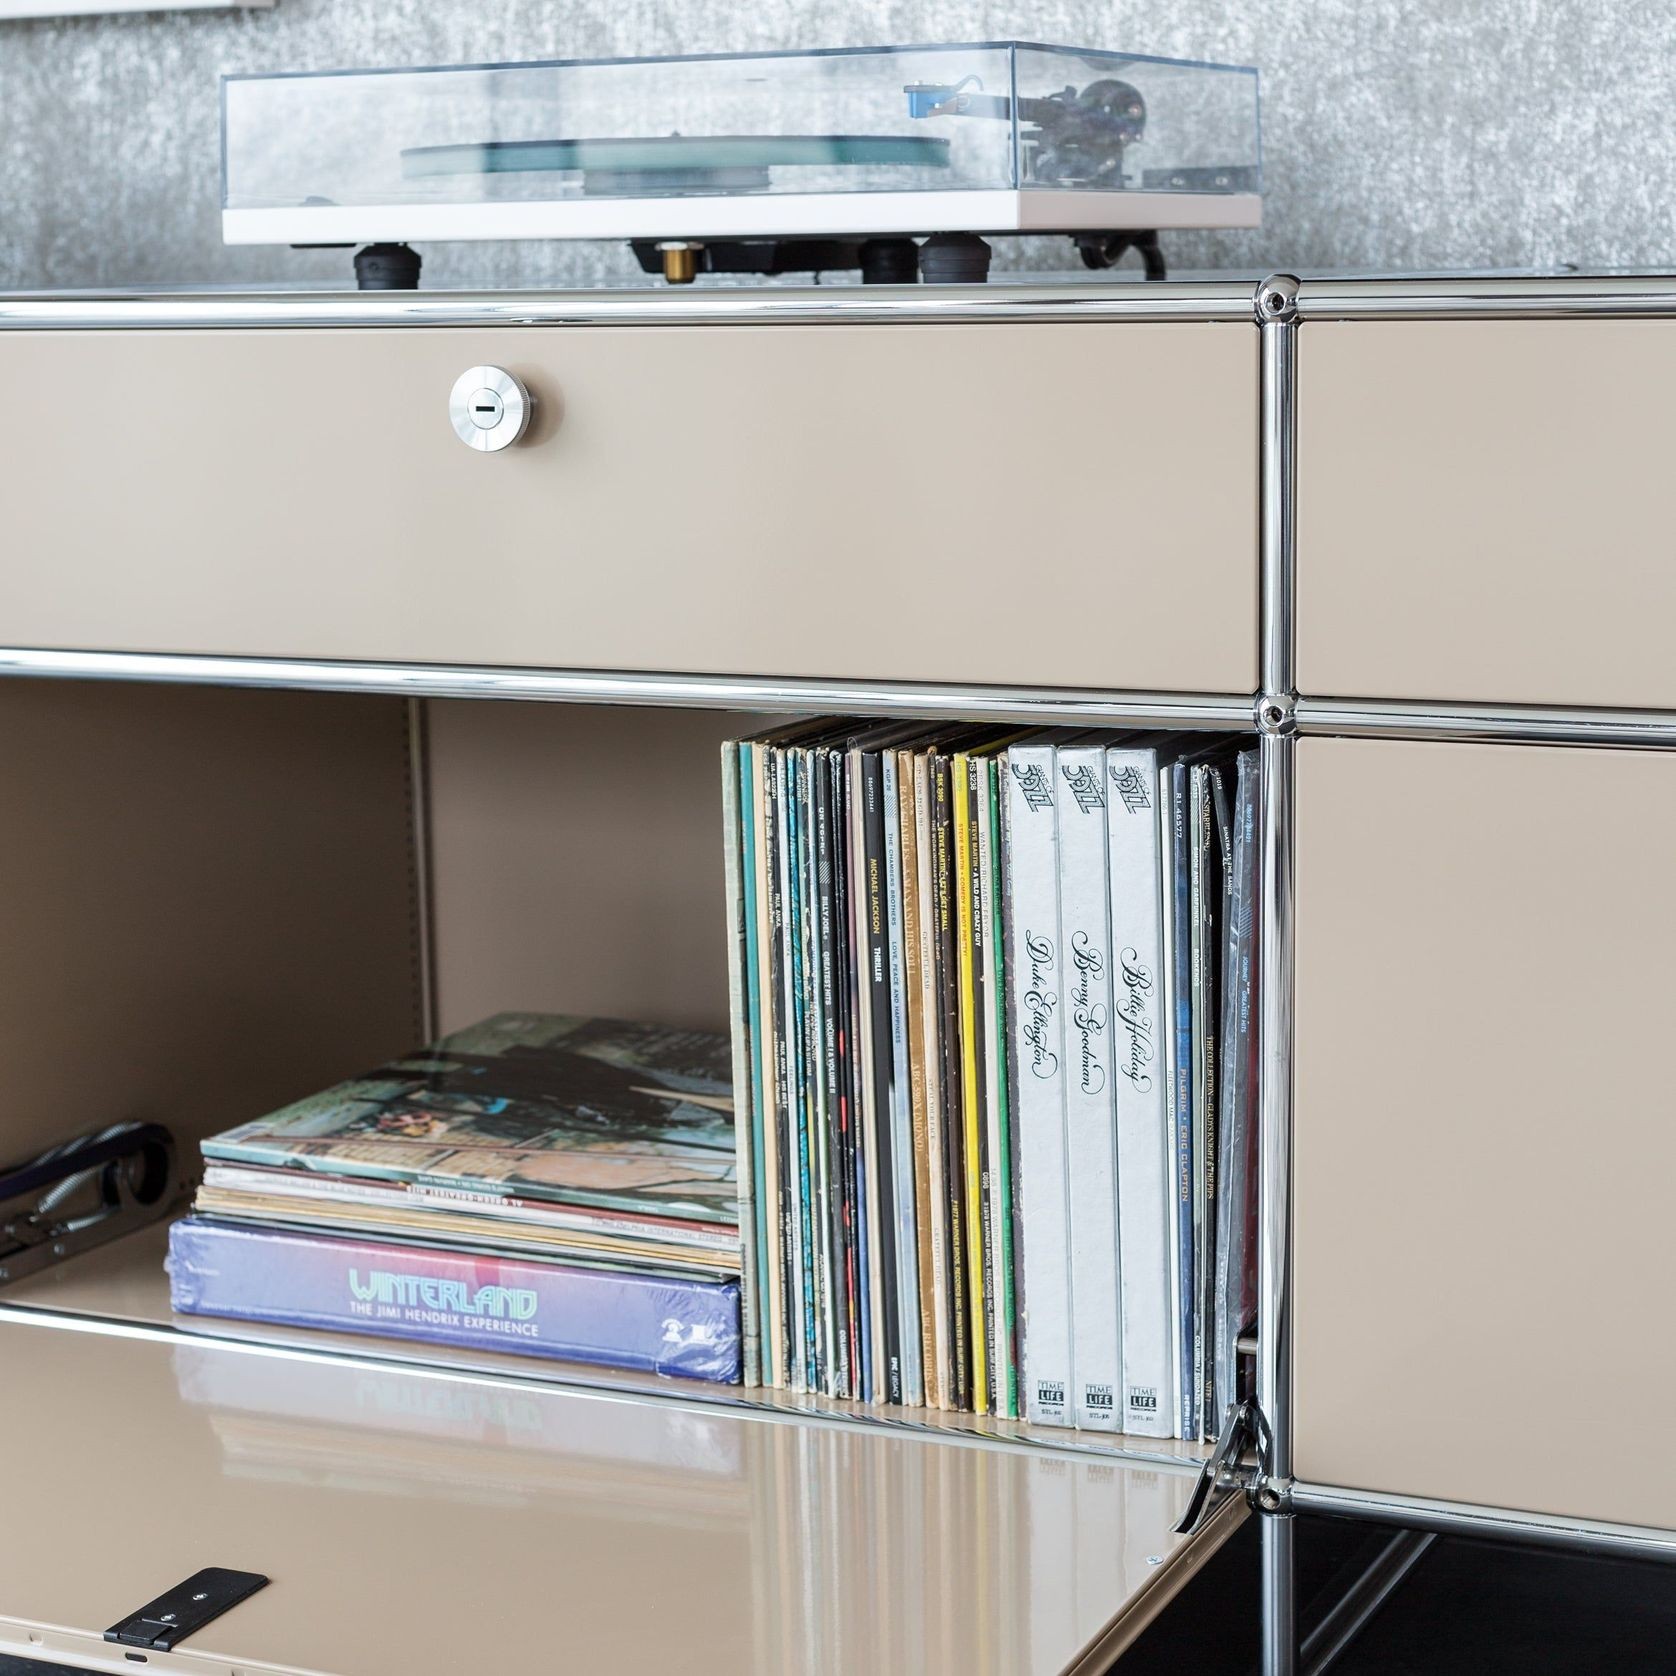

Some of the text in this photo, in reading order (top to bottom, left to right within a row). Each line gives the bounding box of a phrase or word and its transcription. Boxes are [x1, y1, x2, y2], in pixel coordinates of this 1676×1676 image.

[970, 760, 976, 771] HS
[1036, 765, 1049, 785] GIANTS
[1087, 766, 1100, 786] GIANTS
[1133, 766, 1146, 786] GIANTS
[1012, 764, 1054, 812] JAZZ
[1062, 766, 1105, 814] JAZZ
[1109, 766, 1151, 814] JAZZ
[1176, 792, 1181, 804] R1
[901, 809, 910, 860] CHARLES
[1223, 826, 1231, 850] SINATRA
[1227, 852, 1231, 861] AT
[874, 947, 882, 982] THRILLER
[1024, 930, 1058, 1079] Duke Ellington
[1071, 931, 1107, 1095] Benny Goodman
[1116, 947, 1154, 1093] Billie Holiday
[913, 1112, 924, 1152] (MONO)
[348, 1268, 538, 1320] WINTERLAND
[350, 1301, 539, 1336] THE JIMI HENDRIX EXPERIENCE
[923, 1310, 932, 1331] ABC
[924, 1333, 934, 1381] RECORDS
[1041, 1382, 1063, 1390] TIME
[1042, 1392, 1062, 1400] LIFE
[1088, 1386, 1111, 1394] TIME
[1089, 1396, 1110, 1404] LIFE
[1133, 1397, 1155, 1406] LIFE
